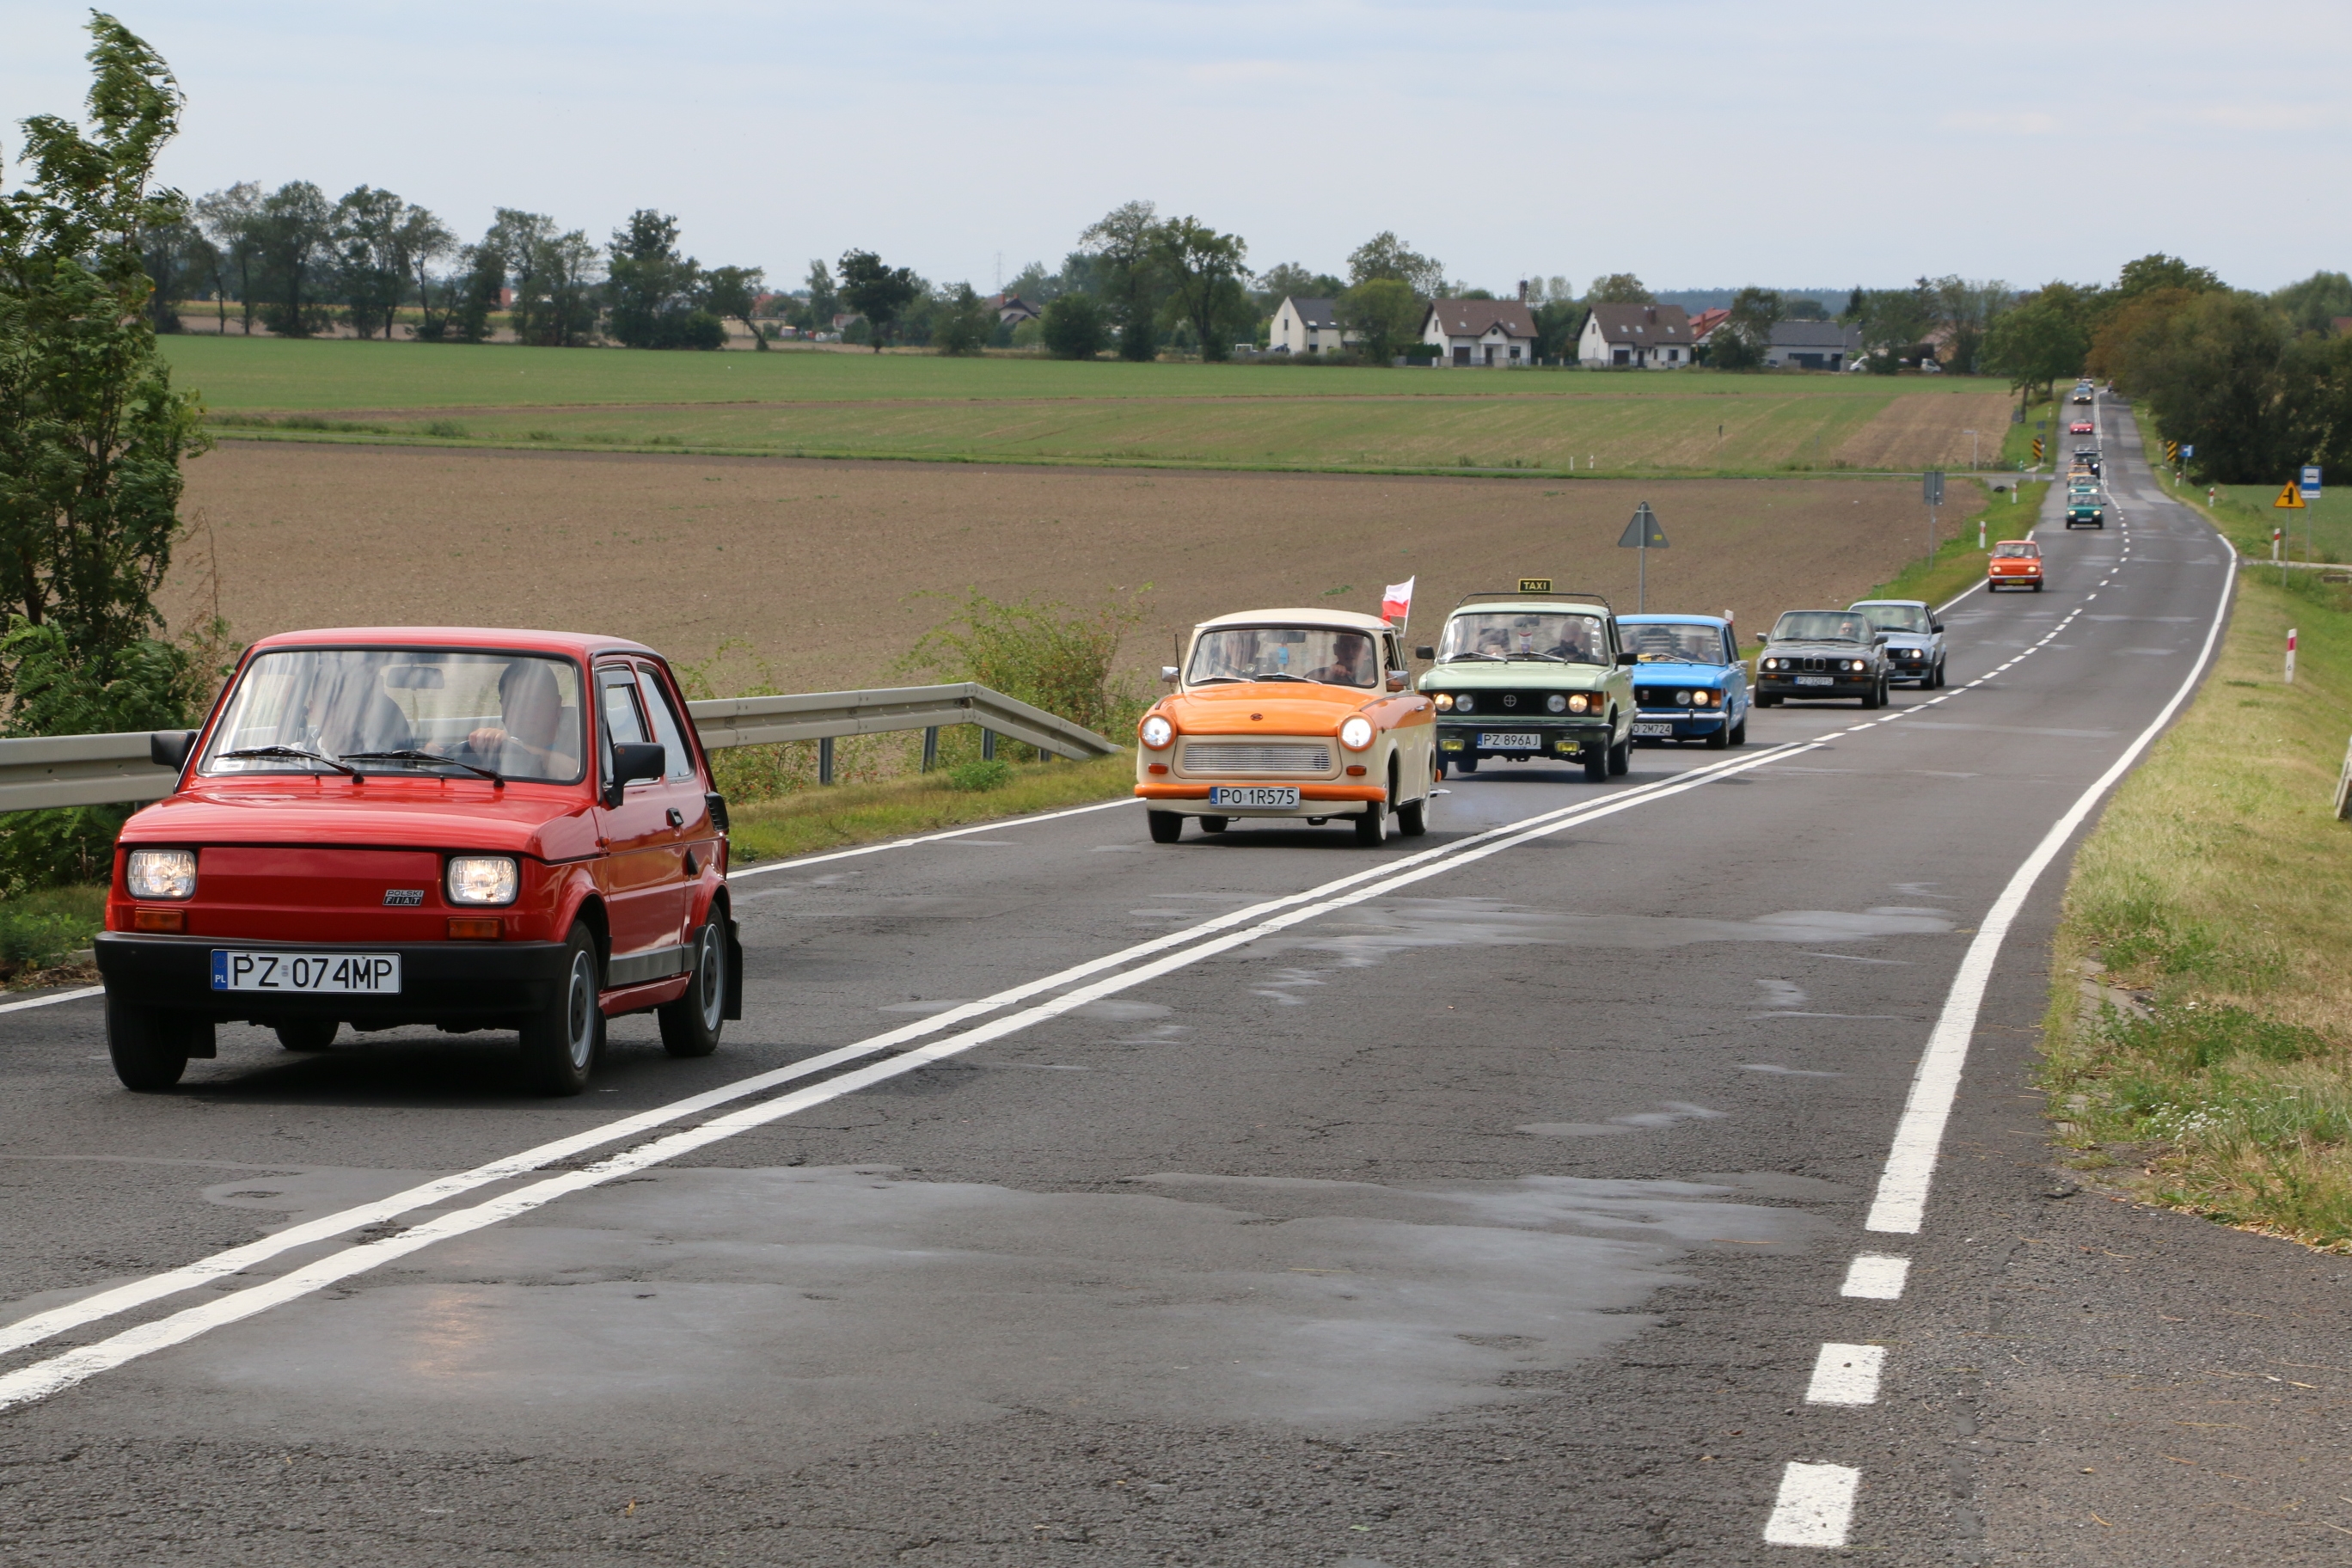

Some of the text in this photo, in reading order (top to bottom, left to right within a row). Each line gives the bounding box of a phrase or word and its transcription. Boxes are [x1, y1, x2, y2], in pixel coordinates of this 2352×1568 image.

[1523, 581, 1547, 591] TAXI
[1642, 724, 1670, 734] 2M724
[1484, 734, 1538, 746] PZ 896AJ
[1220, 789, 1295, 805] PO 1R575
[233, 955, 393, 989] PZ 074MP
[215, 975, 226, 983] PL
